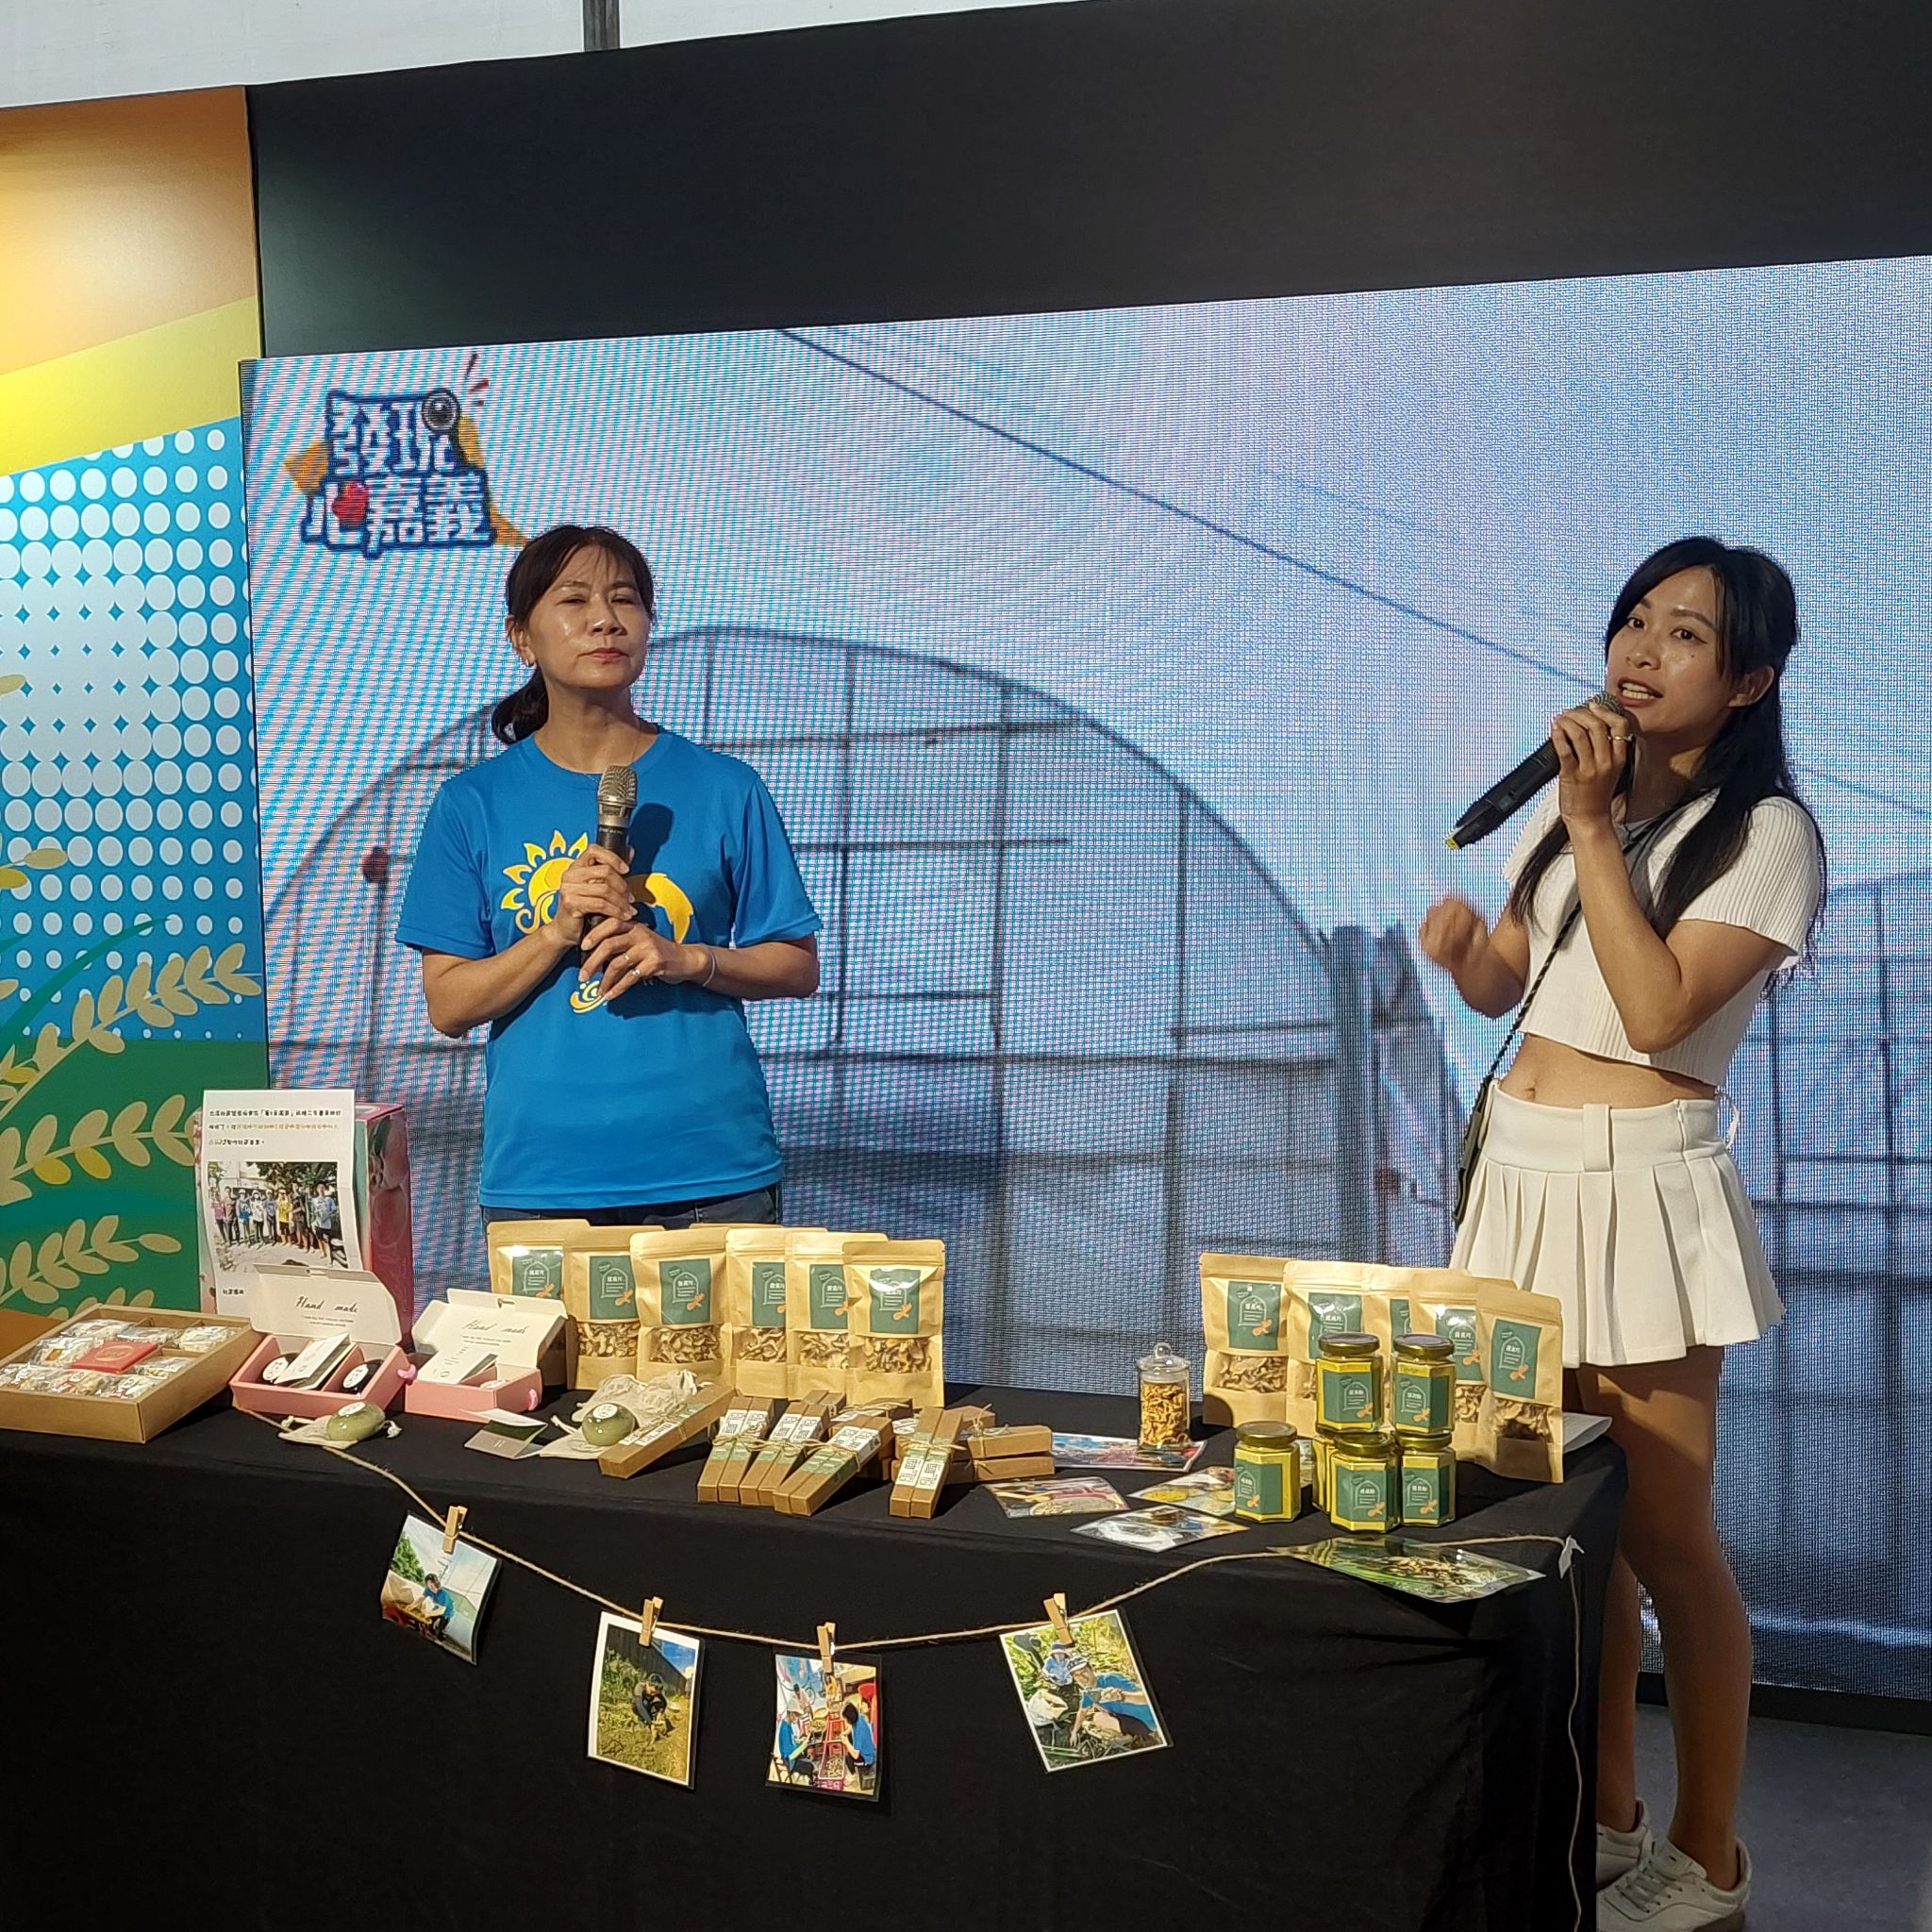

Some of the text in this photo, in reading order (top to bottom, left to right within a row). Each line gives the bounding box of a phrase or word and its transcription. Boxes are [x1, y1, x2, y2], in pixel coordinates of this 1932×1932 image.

[295, 1295, 358, 1313] Hand made
[461, 1319, 498, 1331] Hand
